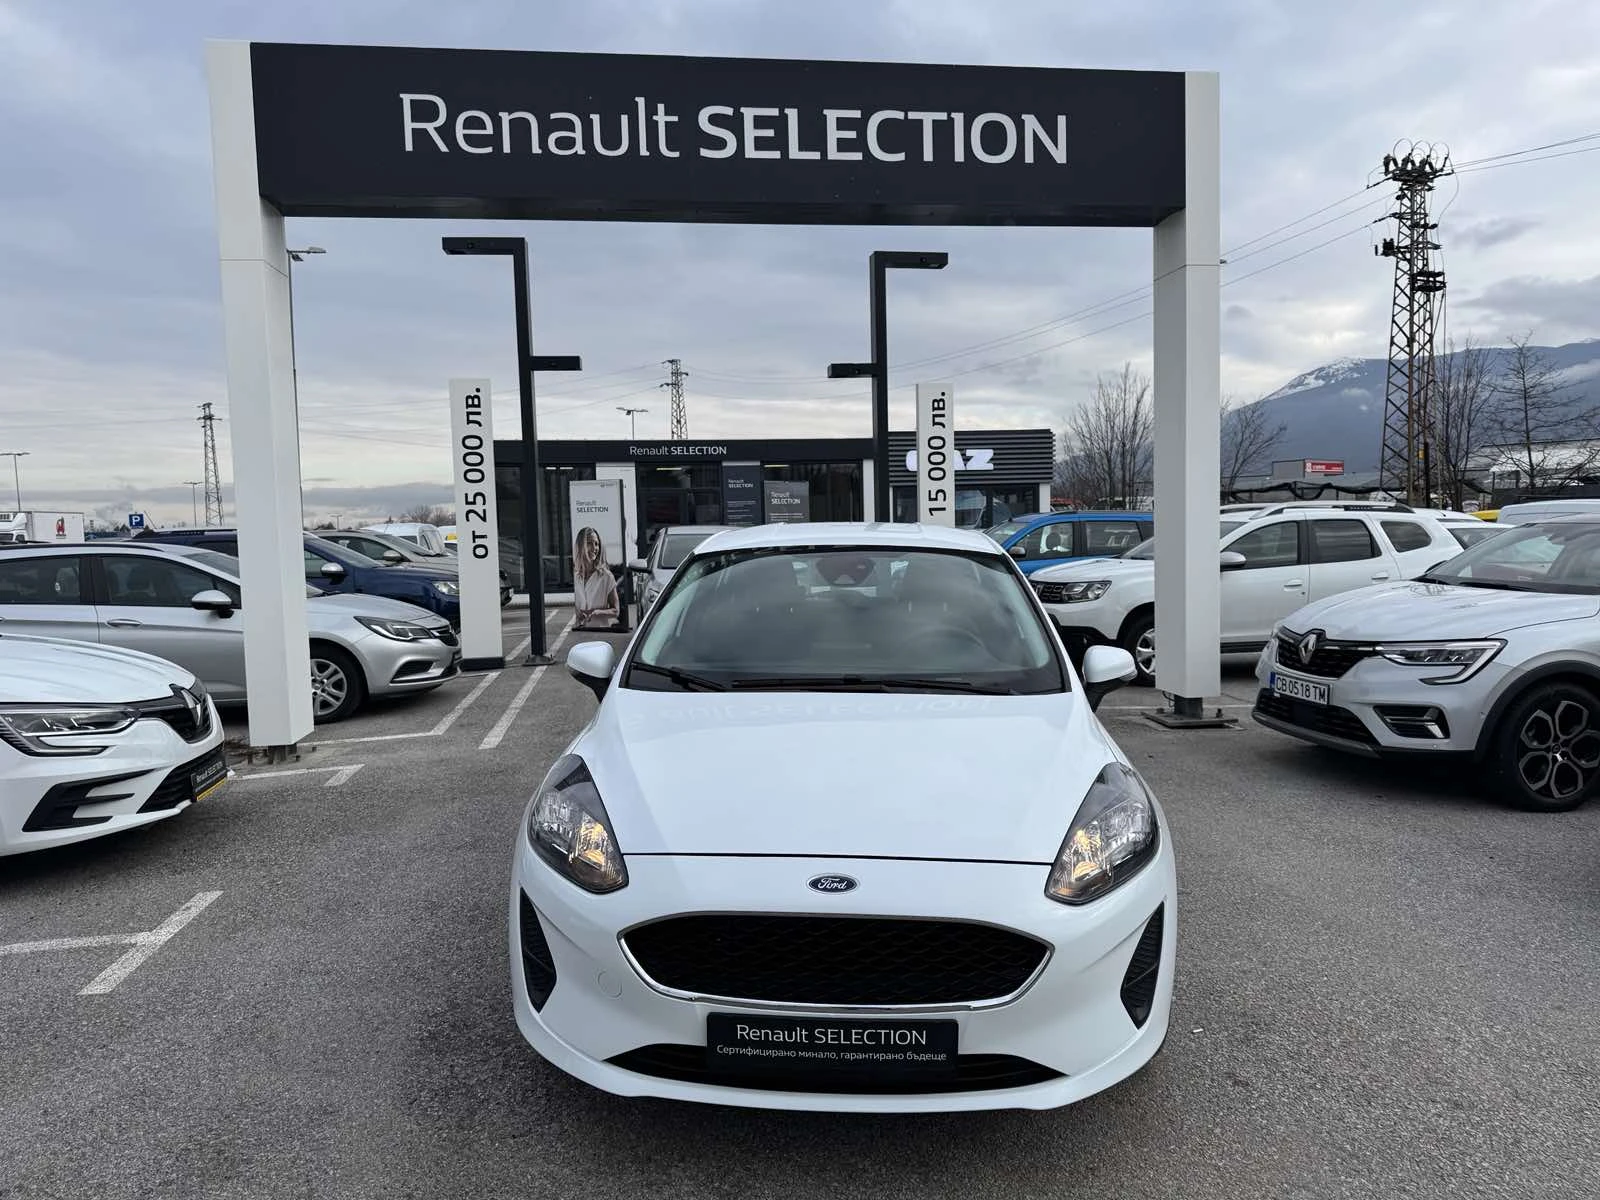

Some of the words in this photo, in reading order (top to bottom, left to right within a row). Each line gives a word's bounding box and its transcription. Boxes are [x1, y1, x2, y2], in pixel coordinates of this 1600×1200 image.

[399, 92, 680, 158] Renault
[698, 105, 1067, 164] SELECTION
[465, 386, 483, 428] лв.
[931, 391, 946, 429] лв.
[461, 434, 486, 484] 000
[629, 446, 670, 456] Renault
[671, 446, 728, 456] SELECTION
[927, 435, 946, 482] 000
[465, 492, 488, 523] 25
[928, 488, 947, 517] 15
[472, 530, 489, 559] от
[1289, 680, 1311, 698] 0518
[1312, 685, 1326, 702] TM
[817, 877, 848, 889] Ford
[736, 1024, 809, 1044] Renault
[814, 1028, 927, 1046] SELECTION
[716, 1044, 797, 1059] Сертифицирано
[798, 1050, 838, 1060] минало,
[840, 1051, 904, 1061] гарантирано
[906, 1051, 948, 1061] бъдеще
